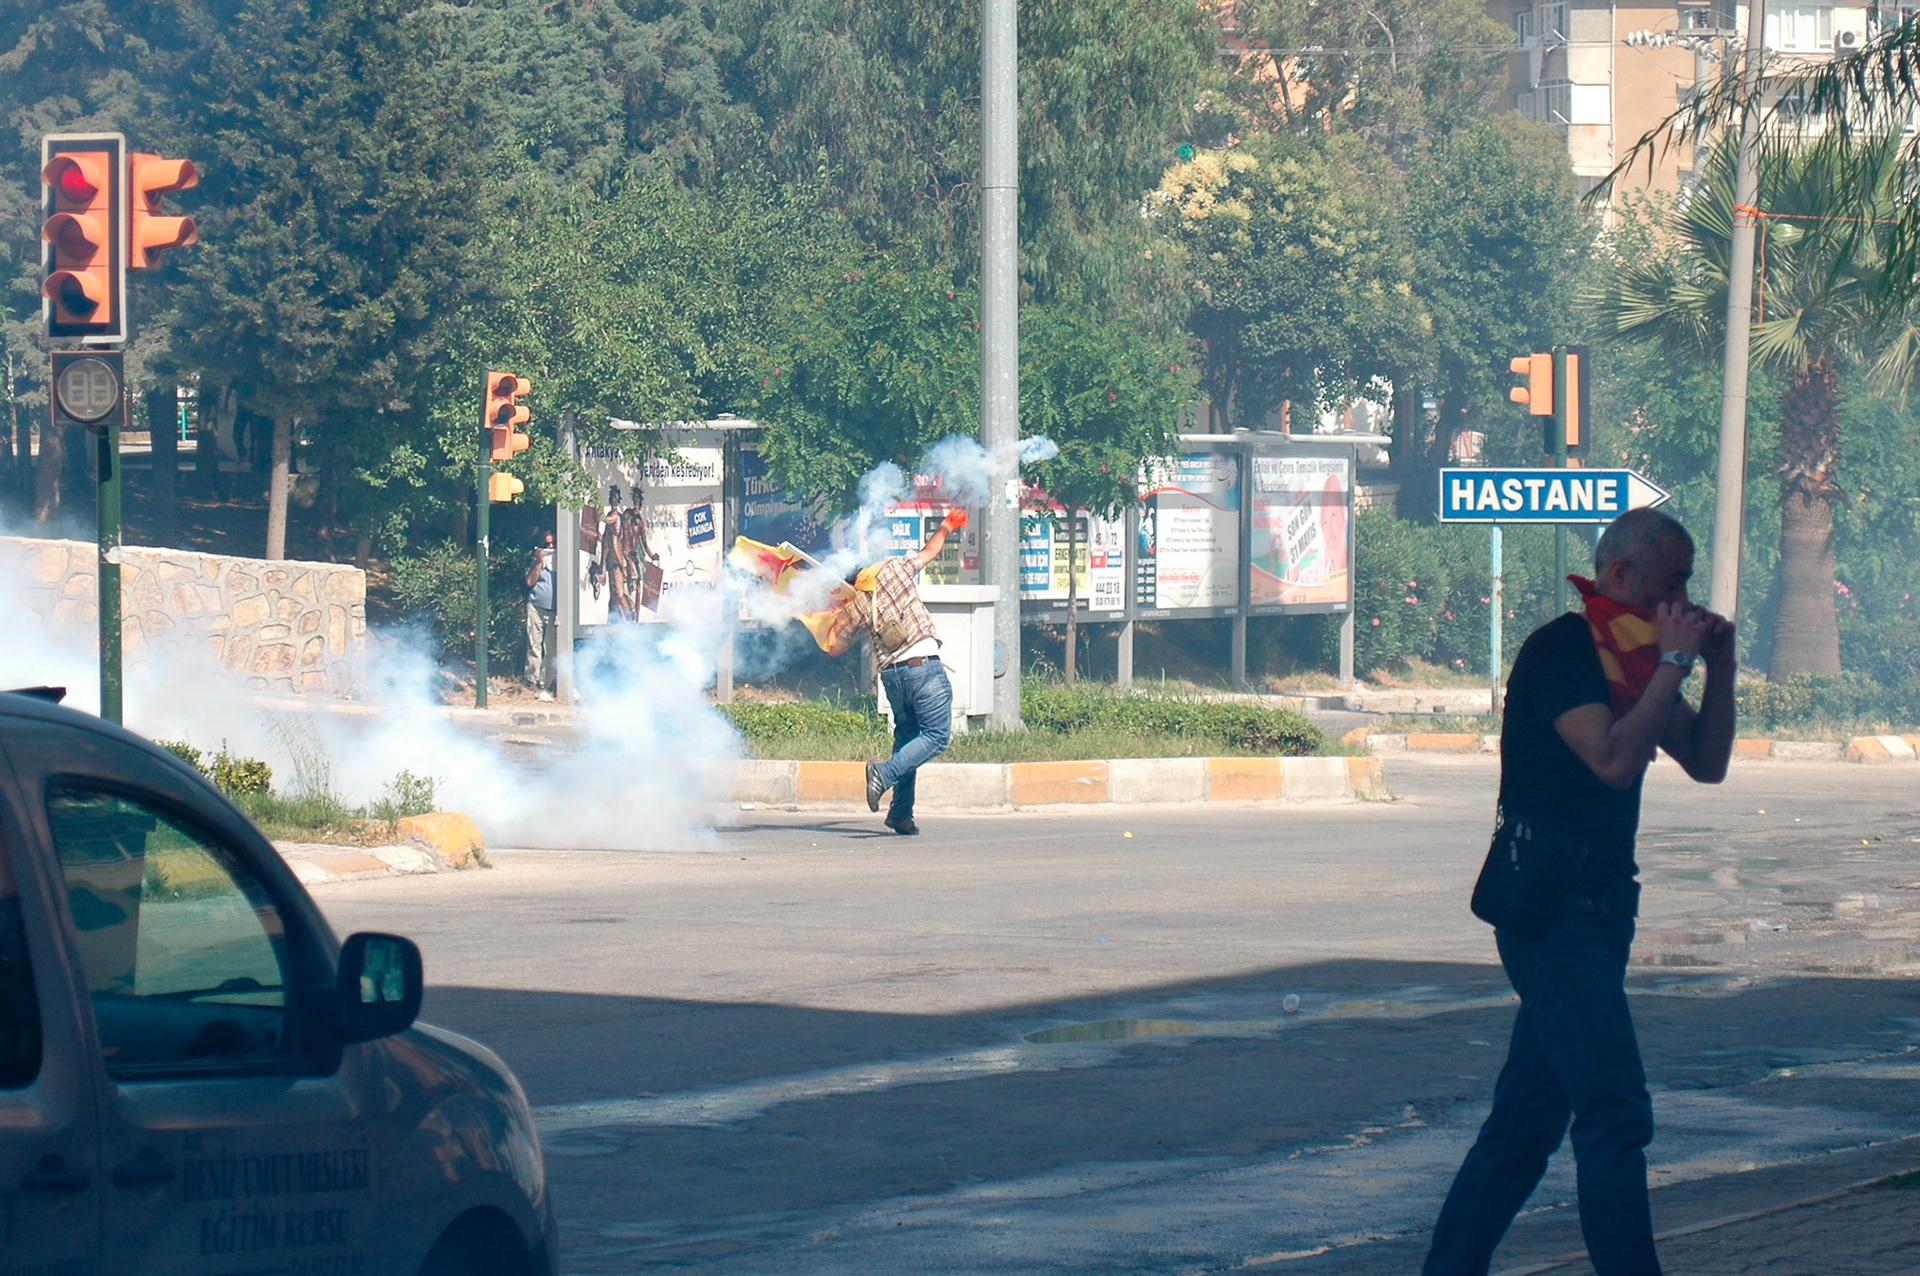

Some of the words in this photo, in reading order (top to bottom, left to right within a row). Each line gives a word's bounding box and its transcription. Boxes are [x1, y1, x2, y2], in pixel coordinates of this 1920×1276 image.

[1452, 478, 1618, 511] HASTANE
[693, 511, 707, 524] ÇOK
[688, 522, 714, 538] YAKINDA
[1287, 515, 1300, 541] SON
[1111, 532, 1118, 546] 72
[1290, 543, 1299, 564] 31
[1298, 521, 1317, 555] MAYIS
[1095, 583, 1105, 595] 444
[1106, 582, 1113, 595] 23
[1114, 582, 1120, 594] 18
